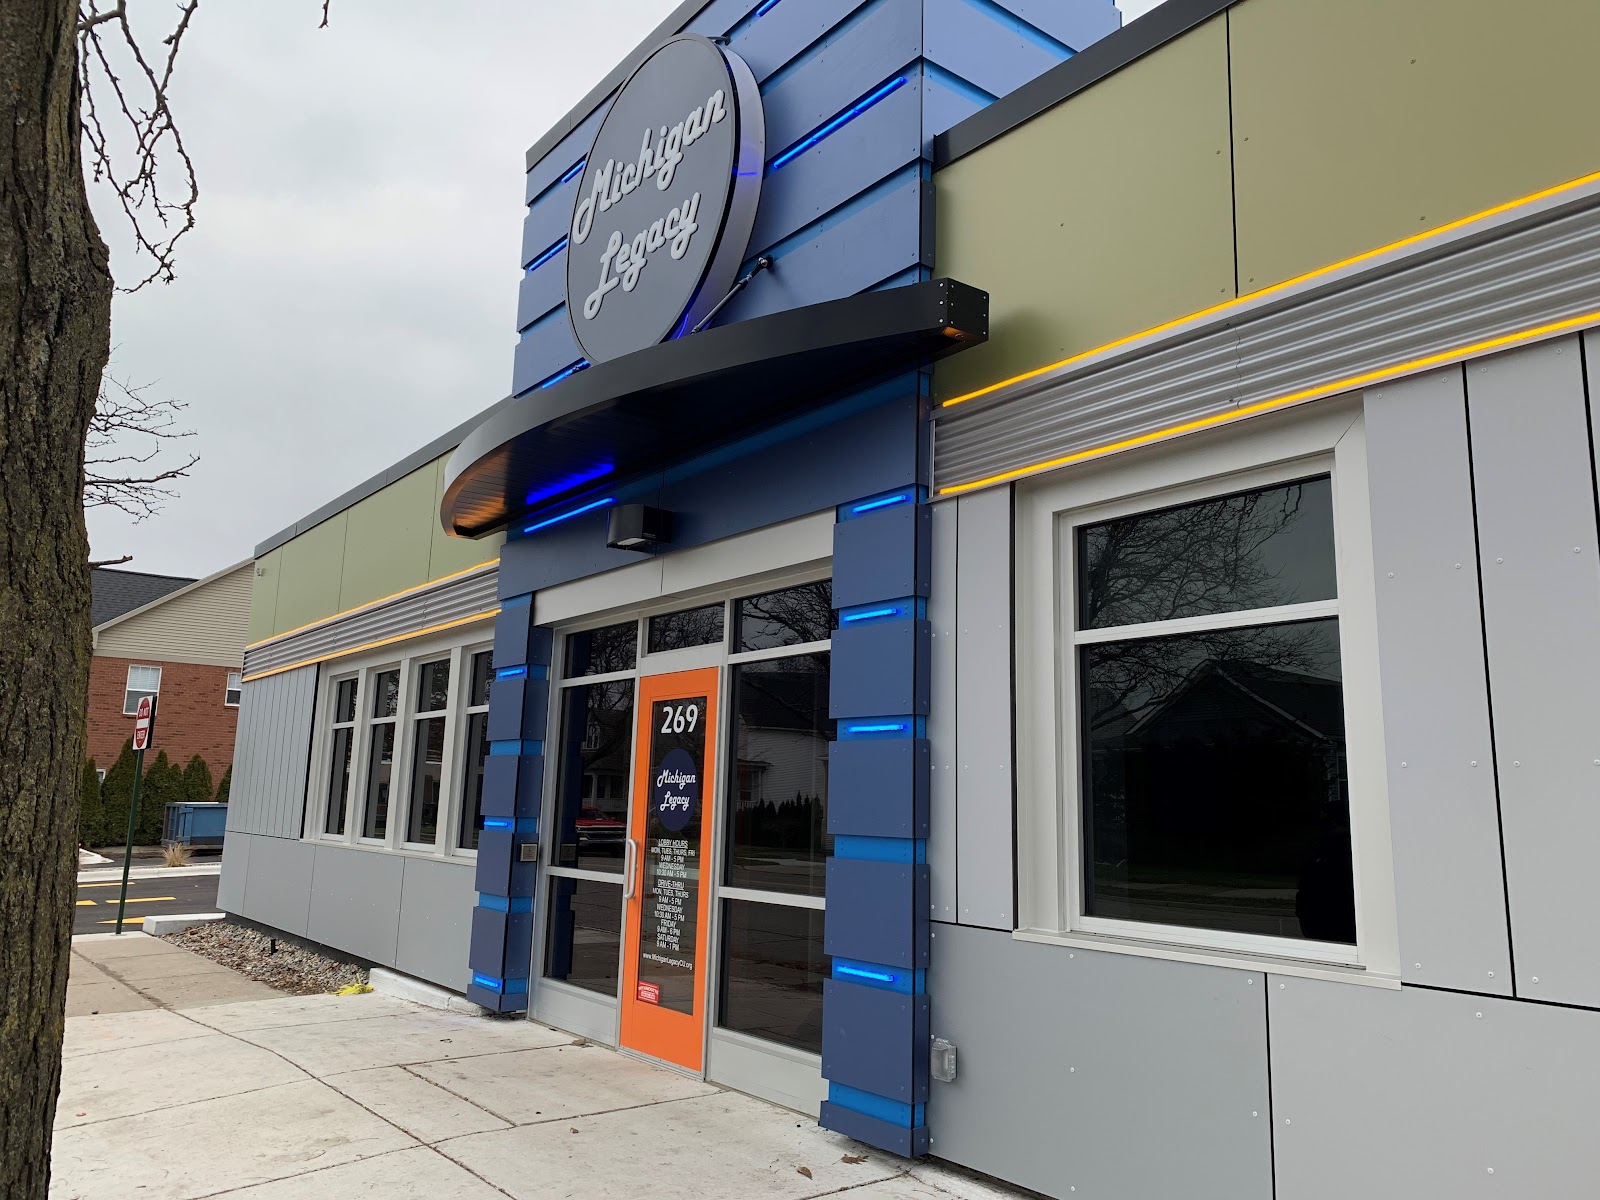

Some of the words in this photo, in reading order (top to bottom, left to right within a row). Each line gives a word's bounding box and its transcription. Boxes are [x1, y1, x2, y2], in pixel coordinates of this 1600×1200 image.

[572, 89, 726, 244] Michigan
[584, 192, 701, 320] Legacy
[661, 704, 698, 734] 269
[657, 769, 696, 790] Michigan
[660, 791, 690, 811] Legacy
[659, 862, 685, 870] WEDNESDAY
[658, 879, 684, 888] DRIVE-THRU
[675, 890, 689, 898] THURS
[657, 903, 683, 913] WEDNESDAY
[661, 919, 676, 928] FRIDAY
[657, 933, 679, 944] SATURDAY
